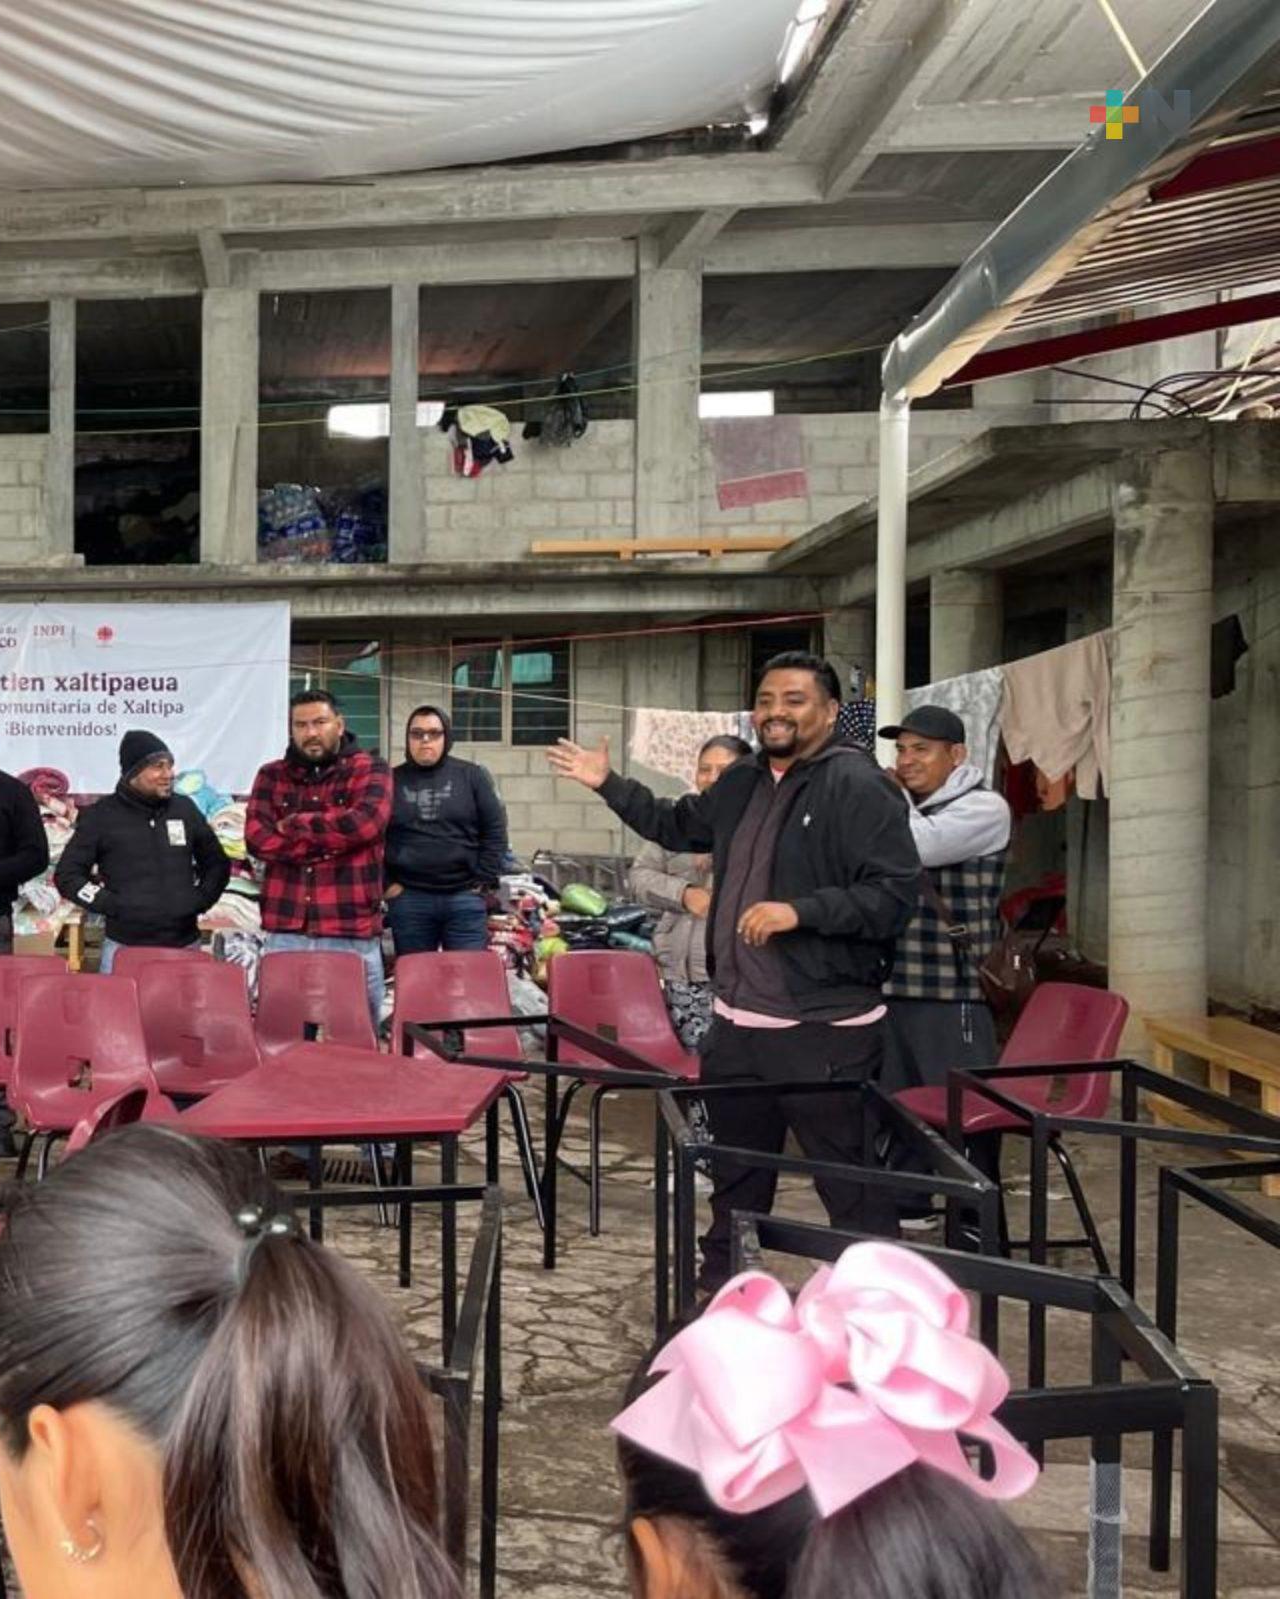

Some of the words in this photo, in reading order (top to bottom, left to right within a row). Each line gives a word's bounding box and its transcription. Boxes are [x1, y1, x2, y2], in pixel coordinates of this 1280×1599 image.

[33, 624, 65, 637] INPI
[55, 672, 179, 696] xaltipaeua
[97, 699, 117, 714] de
[122, 699, 185, 717] Xaltipa
[5, 721, 118, 737] ¡Bienvenidos!
